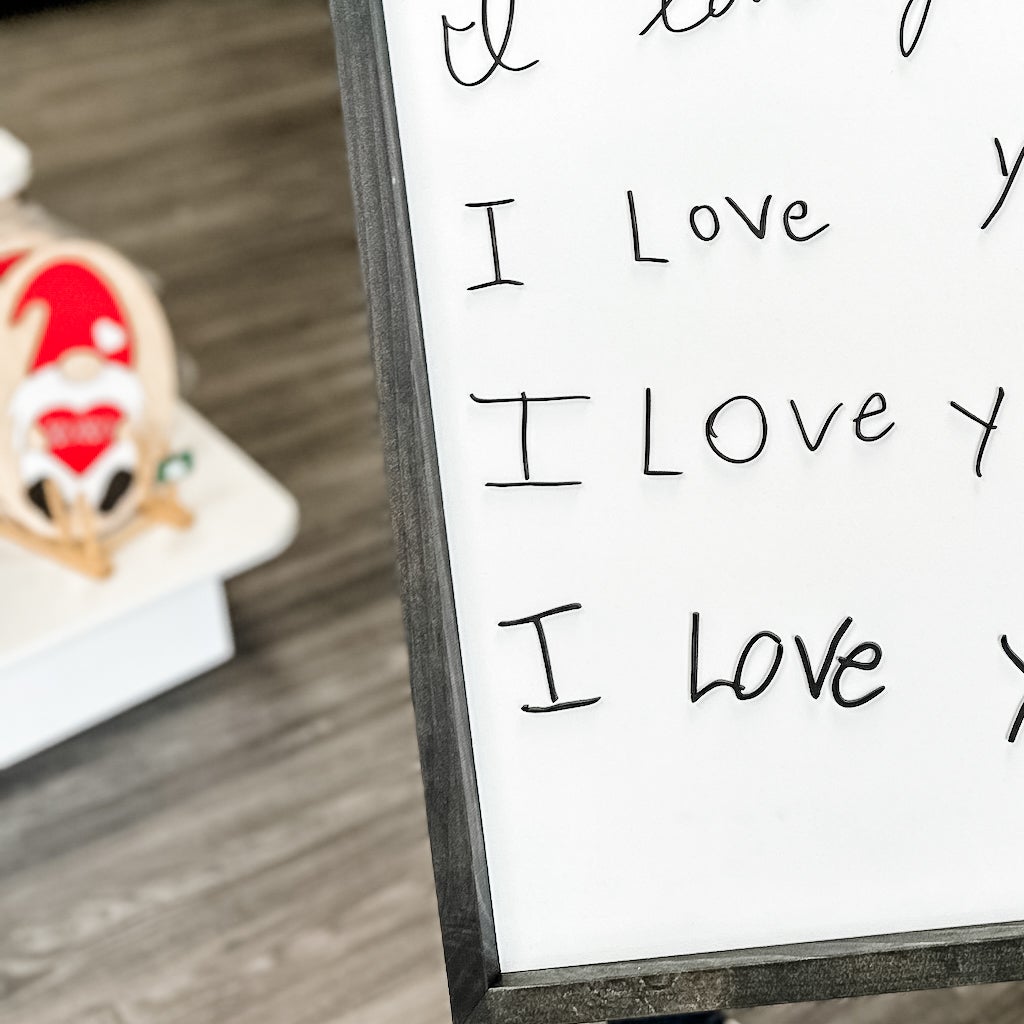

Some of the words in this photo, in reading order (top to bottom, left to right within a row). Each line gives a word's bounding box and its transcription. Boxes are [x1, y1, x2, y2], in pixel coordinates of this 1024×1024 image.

[464, 198, 524, 291] I
[469, 391, 591, 488] I
[497, 602, 602, 714] I
